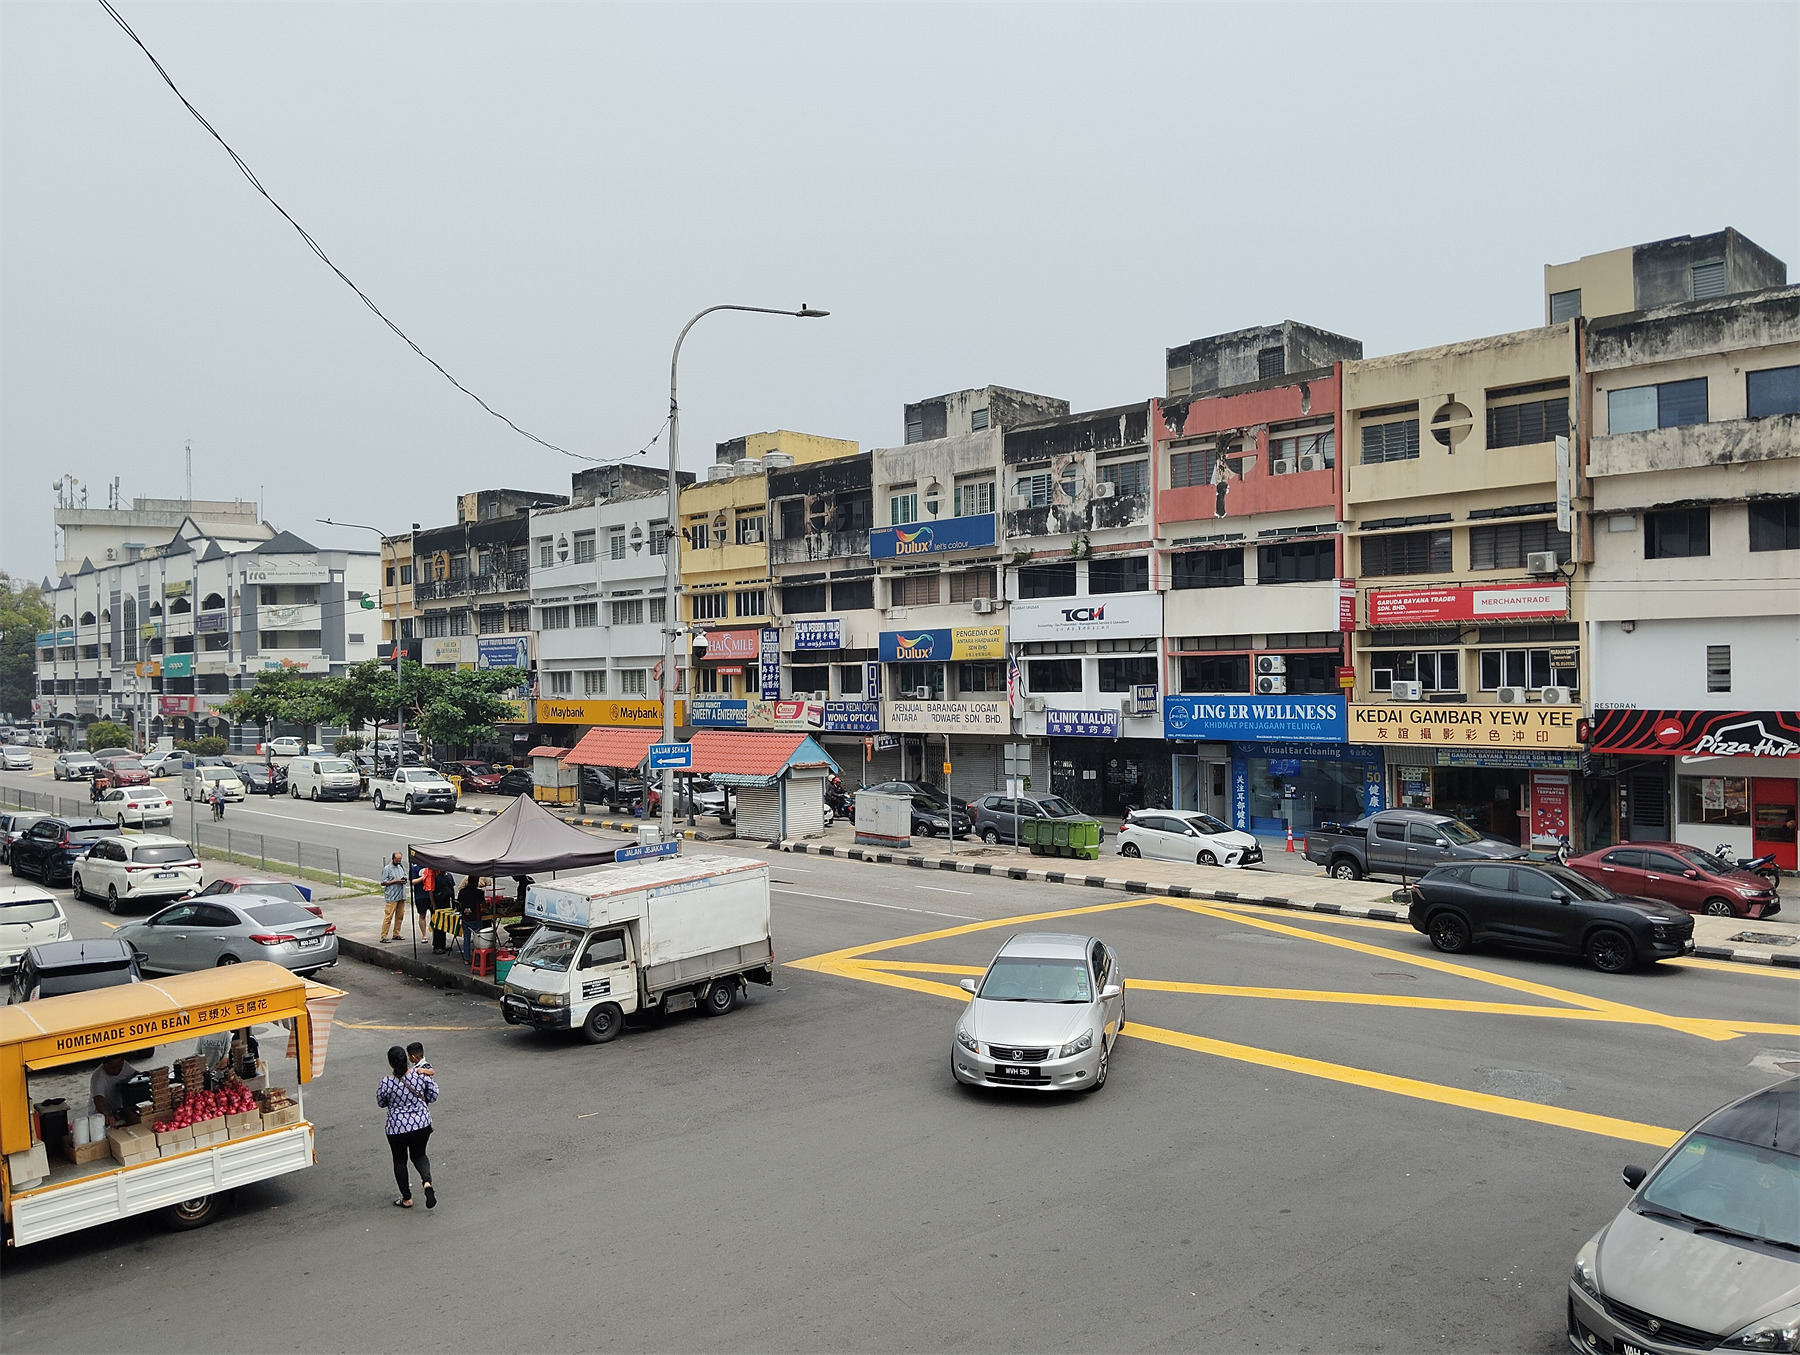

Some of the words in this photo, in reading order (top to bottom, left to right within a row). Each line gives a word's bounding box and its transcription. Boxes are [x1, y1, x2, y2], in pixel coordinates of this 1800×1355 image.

[896, 542, 928, 554] Dulux
[934, 542, 946, 550] let's
[948, 541, 968, 550] colour
[1481, 596, 1550, 605] MERCHANTRADE
[897, 647, 929, 659] Dulux
[1138, 688, 1154, 698] KLINIK
[846, 703, 862, 712] KEDAI
[862, 703, 877, 712] OPTIK
[895, 704, 923, 712] PENJUAL
[927, 704, 967, 712] BARANGAN
[971, 704, 998, 712] LOGAM
[1138, 701, 1155, 710] MALURI
[550, 706, 584, 719] Maybank
[620, 707, 658, 720] Maybank
[692, 709, 711, 719] SWEETY
[712, 709, 716, 720] A
[717, 709, 747, 720] ENTERPRISE
[827, 714, 848, 722] WONG
[850, 714, 878, 722] OPTICAL
[1048, 712, 1079, 723] KLINIK
[1081, 713, 1116, 724] MALURI
[1192, 705, 1226, 720] JING
[1228, 705, 1249, 719] ER
[1252, 704, 1337, 720] WELLNESS
[1356, 710, 1402, 723] KEDAI
[1410, 710, 1482, 724] GAMBAR
[1490, 712, 1529, 725] YEW
[1537, 712, 1572, 726] YEE
[892, 714, 917, 722] ANTARA
[964, 714, 982, 723] SDN.
[986, 715, 1002, 723] BHD.
[1287, 722, 1321, 731] TELINGA
[1694, 734, 1751, 755] Pizza
[1752, 738, 1799, 757] Hut
[1304, 747, 1341, 757] Cleaning
[1366, 772, 1381, 783] 50
[1368, 784, 1380, 808] 健康
[1236, 776, 1246, 829] 关注耳部健康
[625, 848, 641, 857] JALAN
[644, 845, 663, 854] JEJAKA
[197, 1006, 230, 1023] 豆漿水
[235, 999, 268, 1015] 豆腐花
[57, 1027, 125, 1050] HOMEMADE
[129, 1020, 158, 1036] SOYA
[161, 1015, 190, 1030] BEAN
